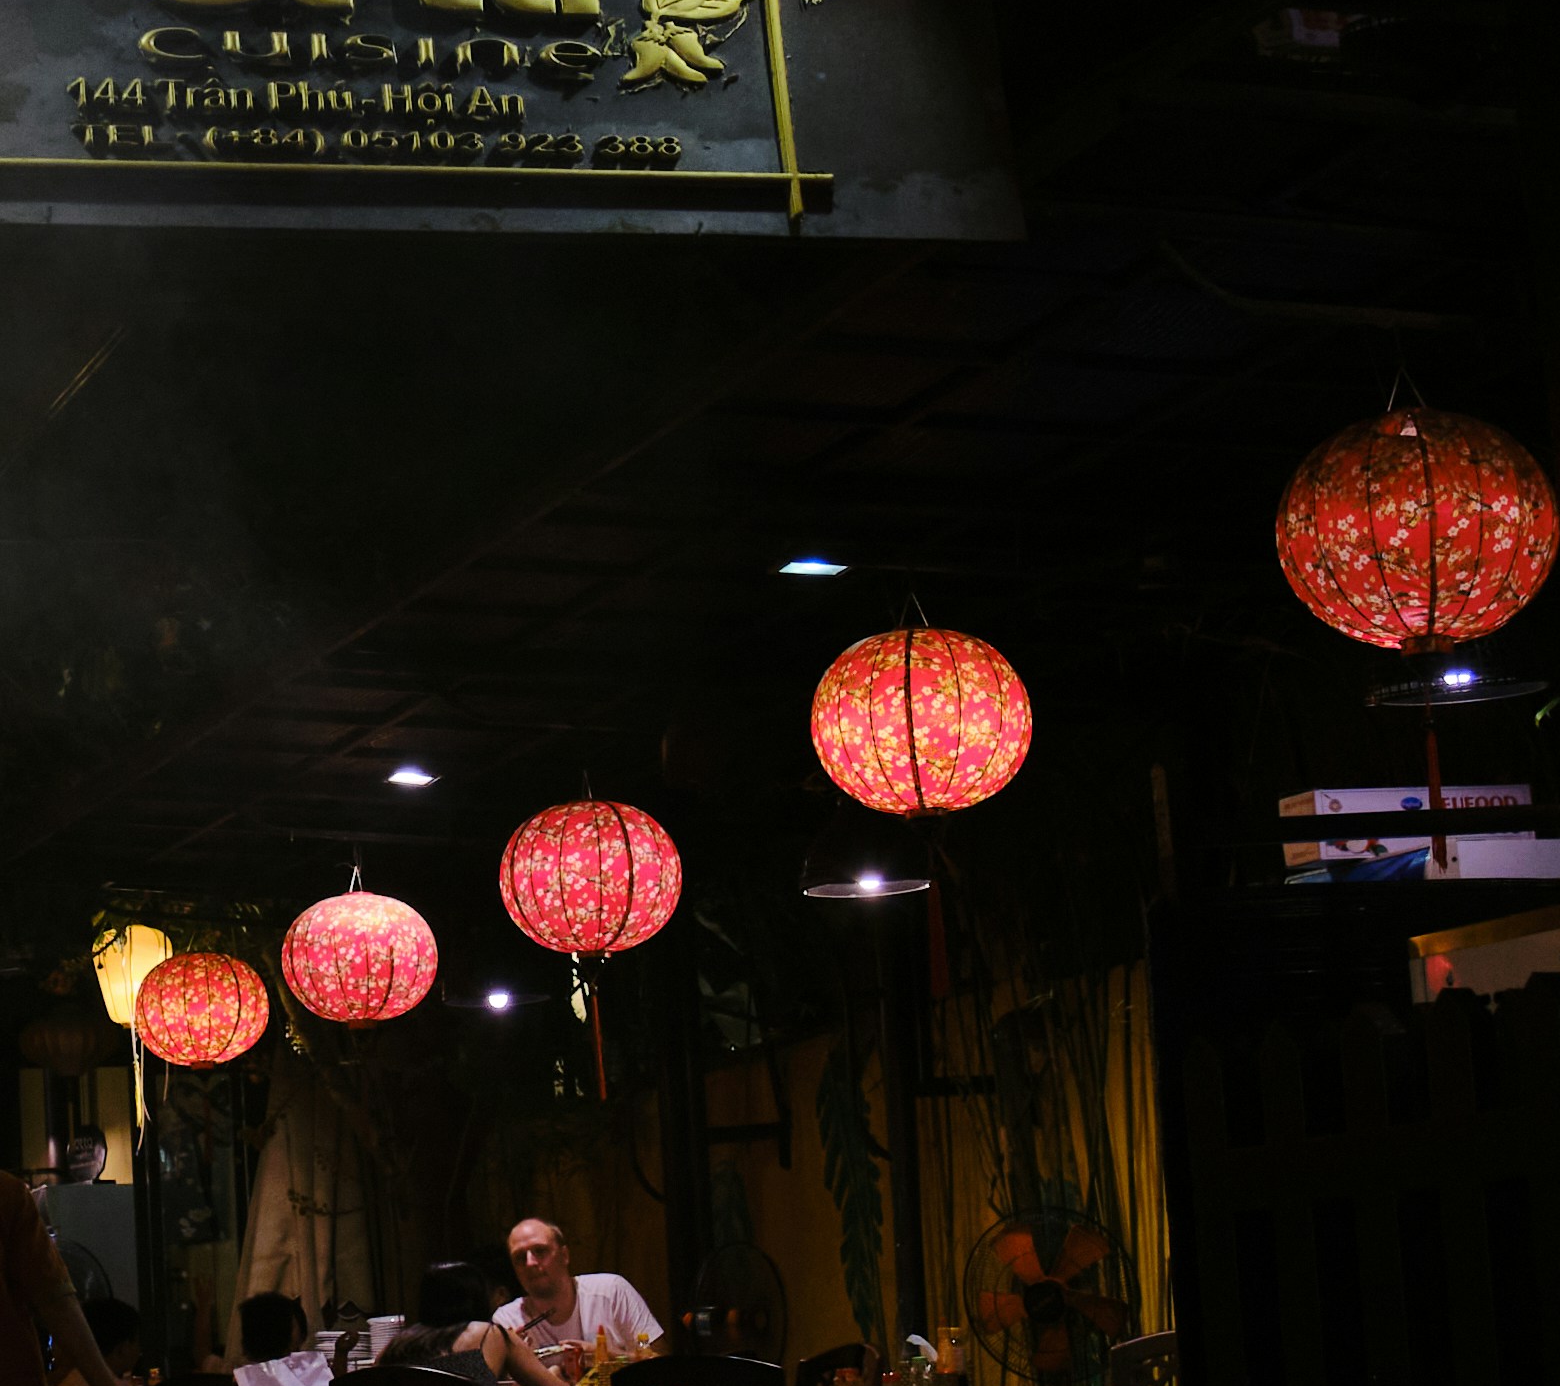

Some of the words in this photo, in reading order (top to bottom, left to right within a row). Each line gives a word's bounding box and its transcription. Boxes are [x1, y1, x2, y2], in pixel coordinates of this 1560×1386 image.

[67, 77, 146, 109] 144
[468, 85, 526, 115] An
[202, 125, 326, 156] (+84)
[340, 128, 484, 153] 05103
[500, 132, 583, 153] 923
[597, 134, 681, 156] 388
